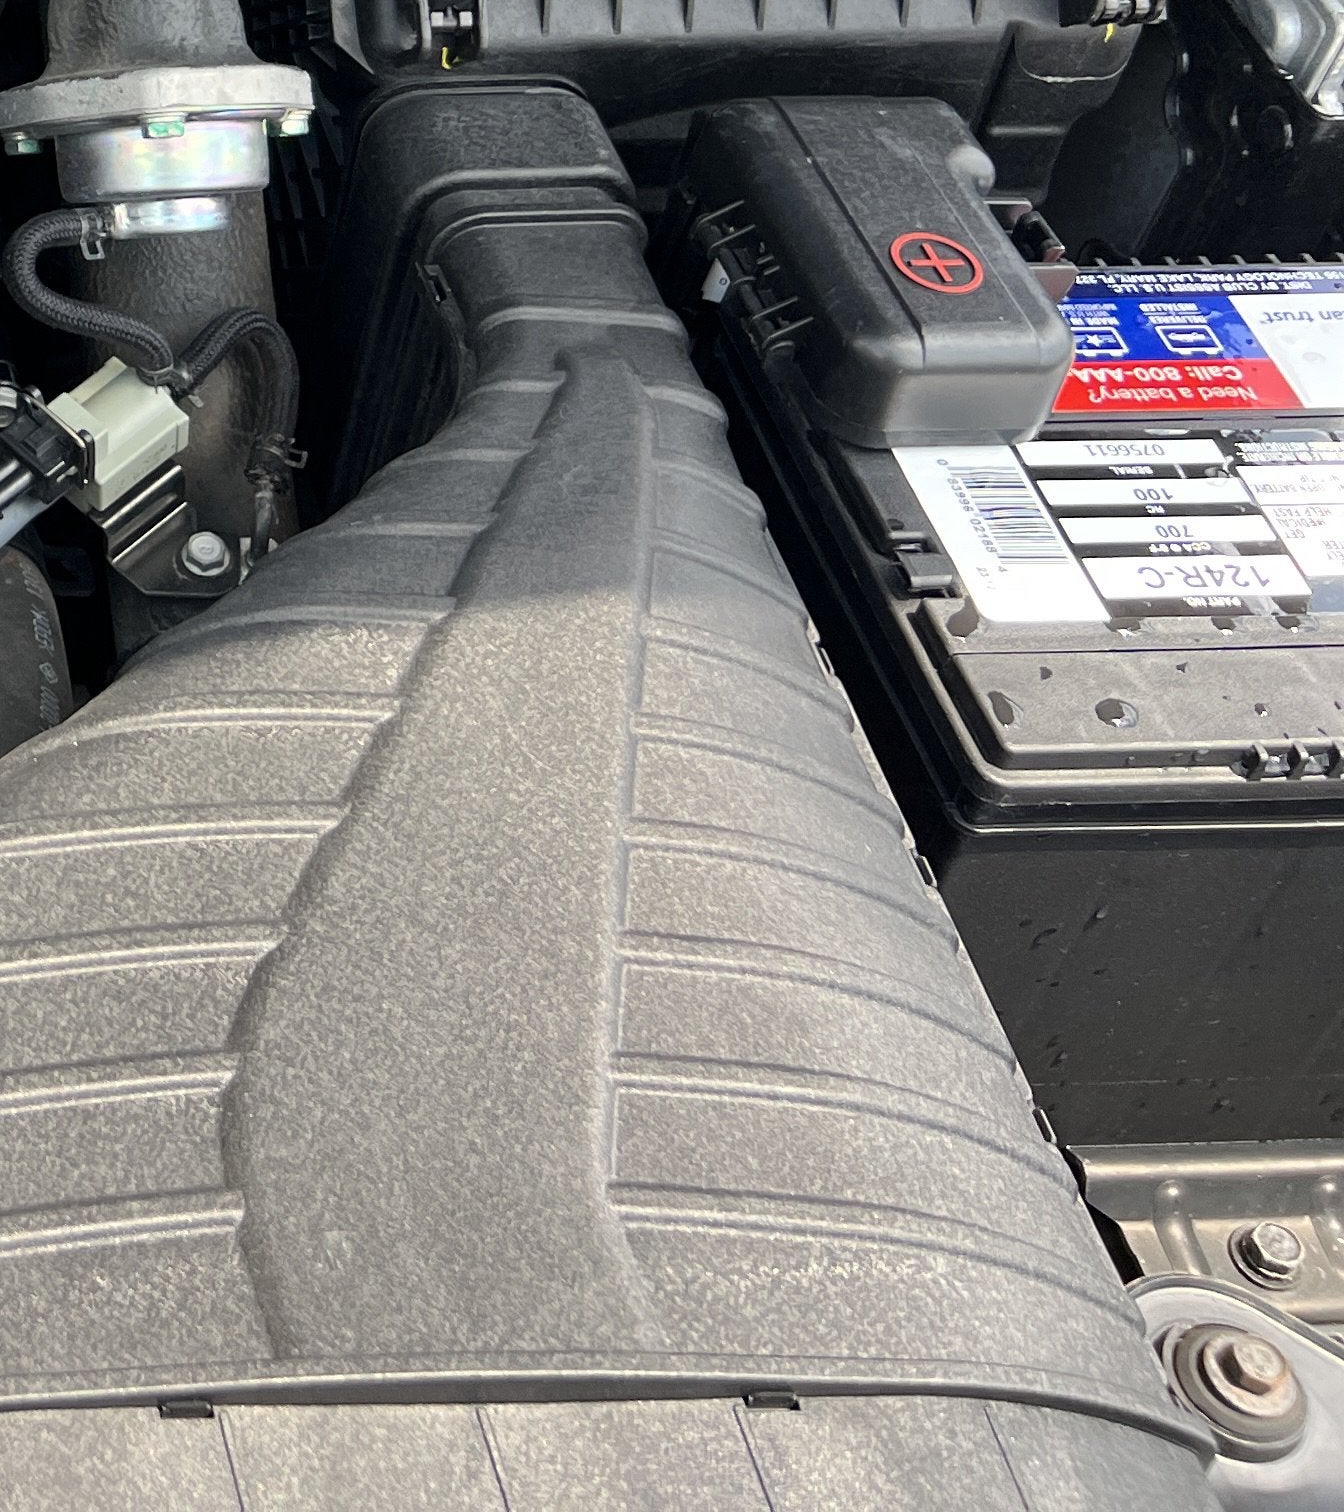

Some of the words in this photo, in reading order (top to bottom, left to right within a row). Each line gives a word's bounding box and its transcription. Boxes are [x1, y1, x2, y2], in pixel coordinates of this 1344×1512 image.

[1223, 281, 1258, 291] CLUB
[1185, 365, 1243, 381] Call:
[1088, 385, 1174, 404] battery?
[1177, 385, 1193, 400] a
[1197, 385, 1257, 402] Need
[1084, 443, 1165, 457] 0756611
[1109, 465, 1153, 476] SERIAL
[1133, 488, 1173, 501] 100
[1146, 504, 1166, 514] RC
[1154, 524, 1193, 538] 700
[1283, 529, 1306, 539] GET
[1136, 563, 1271, 589] 124R-C
